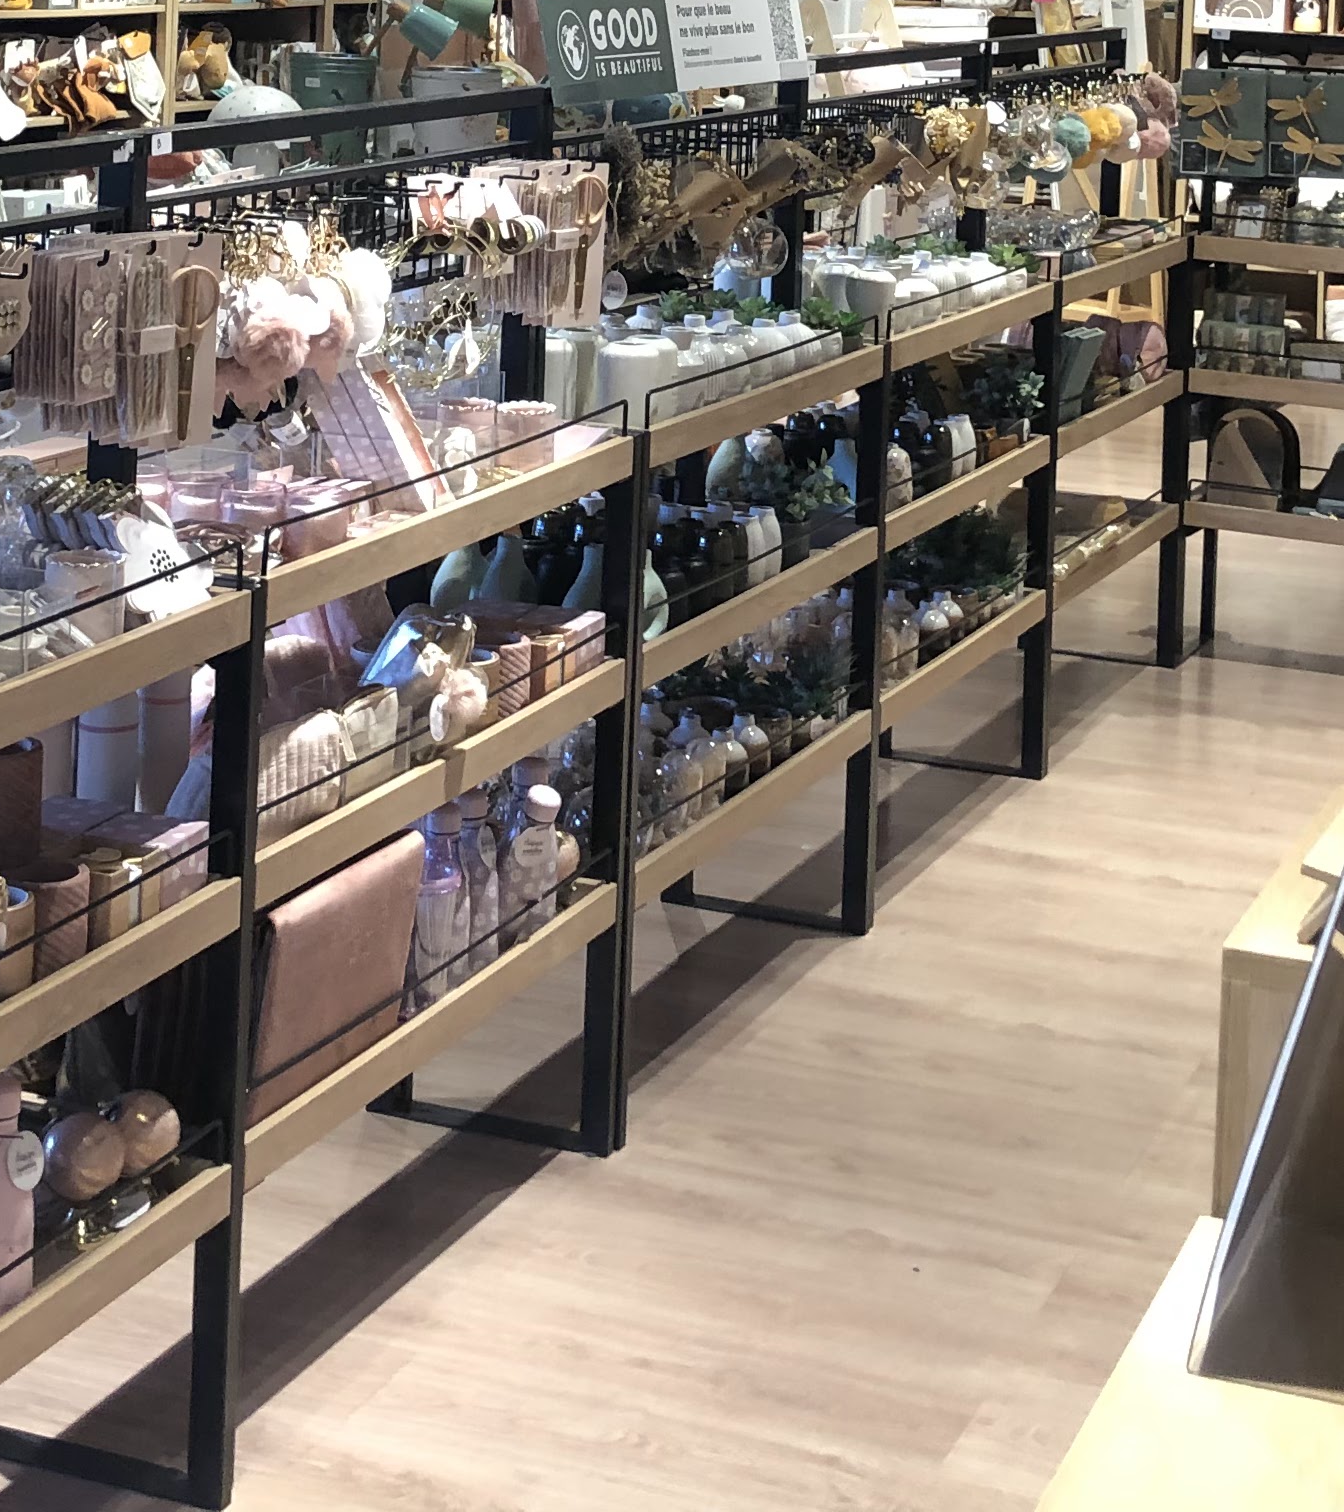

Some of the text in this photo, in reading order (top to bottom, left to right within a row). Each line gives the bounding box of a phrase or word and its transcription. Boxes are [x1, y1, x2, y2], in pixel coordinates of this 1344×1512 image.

[676, 3, 731, 18] Pour que le beau
[589, 7, 657, 51] GOOD
[680, 21, 755, 38] ne vive plus sans le bon
[595, 62, 607, 77] IS
[610, 56, 663, 76] BEAUTIFUL
